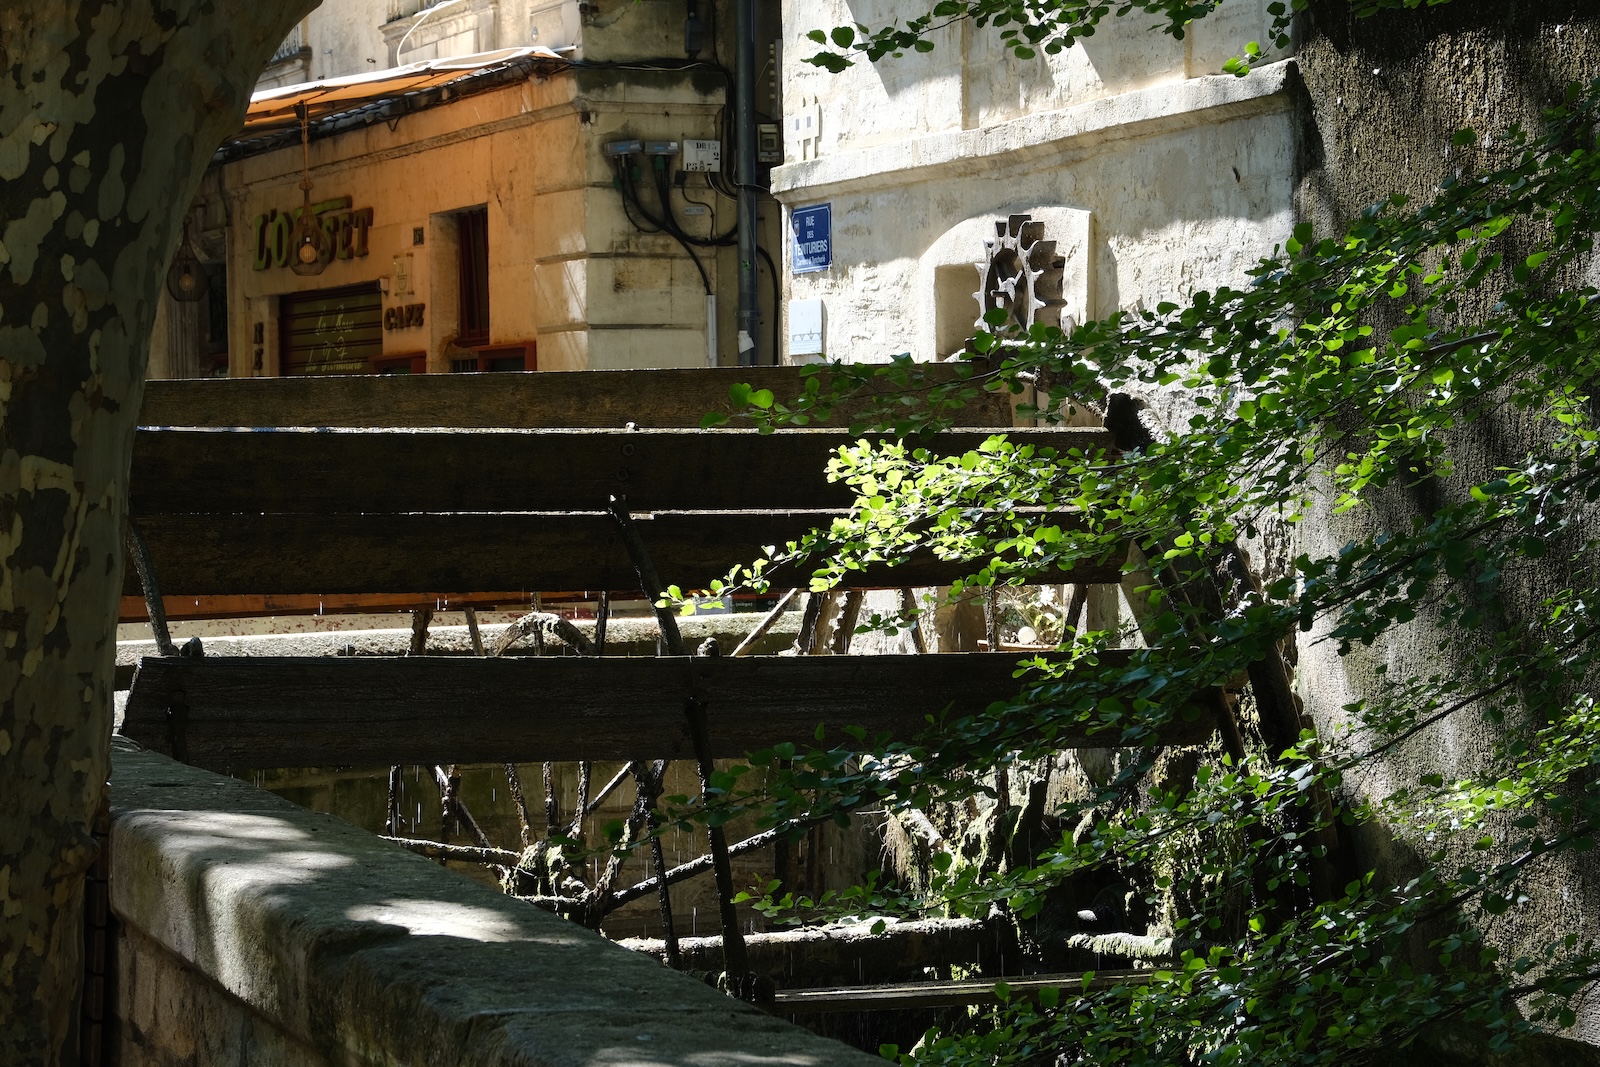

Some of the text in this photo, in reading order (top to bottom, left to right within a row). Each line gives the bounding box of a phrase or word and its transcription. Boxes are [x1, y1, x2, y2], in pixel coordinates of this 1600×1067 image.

[805, 215, 815, 227] RUE
[806, 230, 815, 239] DES
[794, 239, 828, 257] TEINTURIERS
